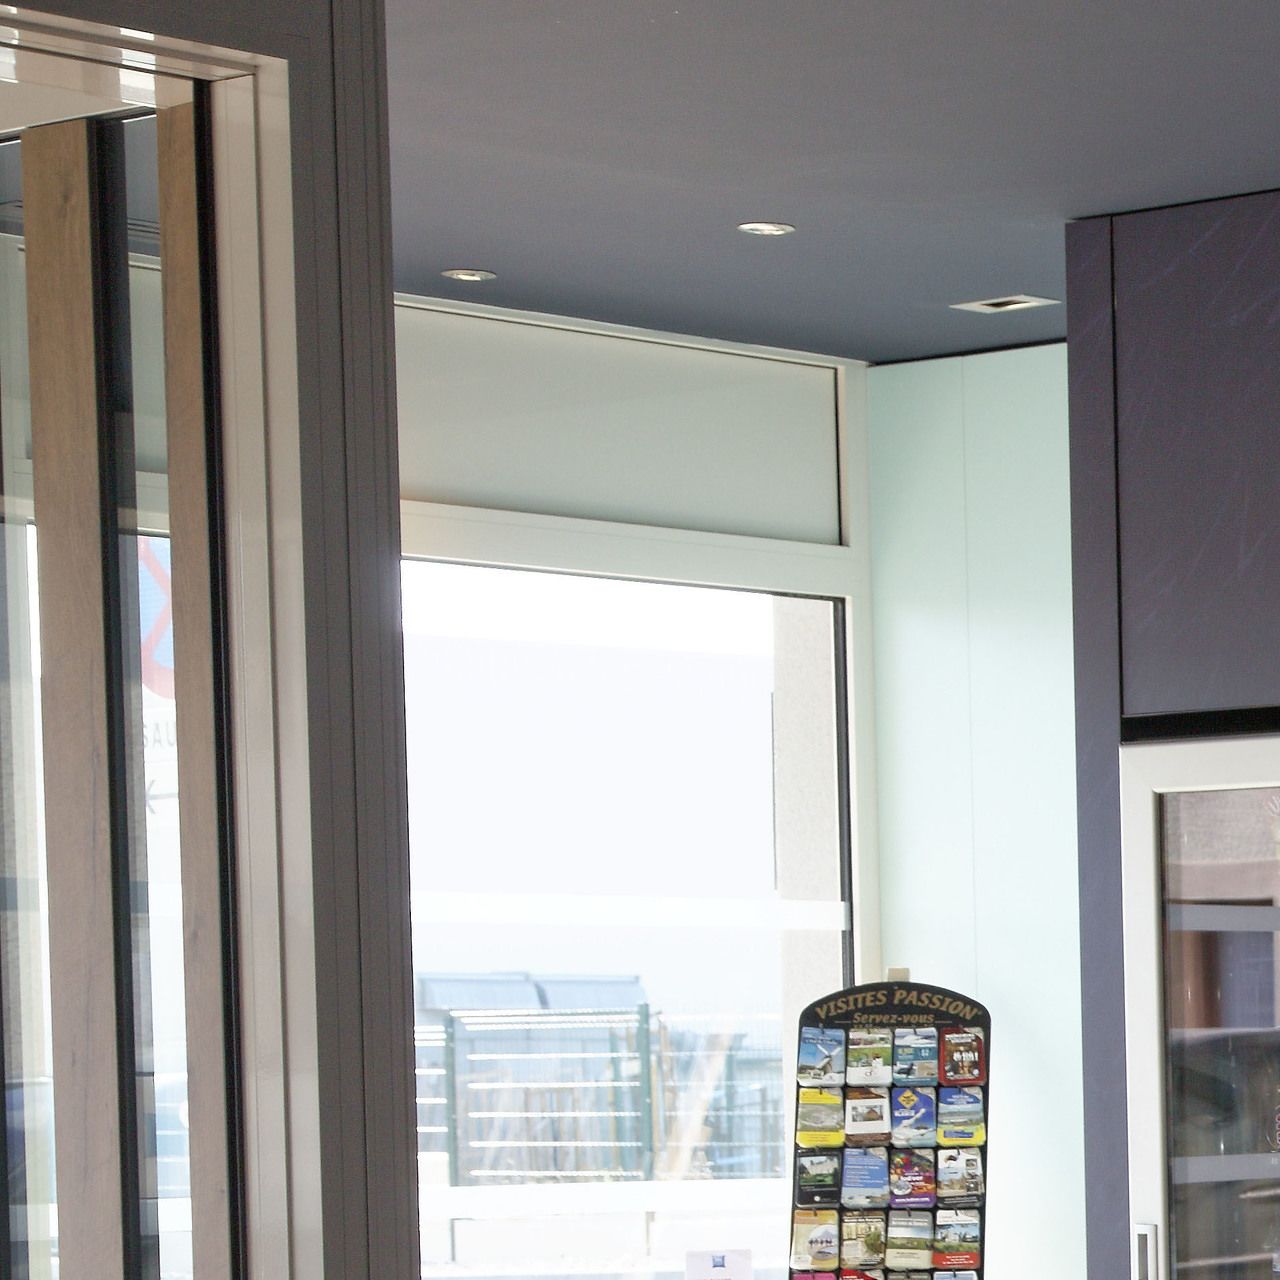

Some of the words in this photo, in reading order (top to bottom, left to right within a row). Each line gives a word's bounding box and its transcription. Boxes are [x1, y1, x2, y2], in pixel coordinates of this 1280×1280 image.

[815, 989, 889, 1020] VISITES
[892, 987, 978, 1021] PASSION
[852, 1011, 936, 1025] Servez-vous
